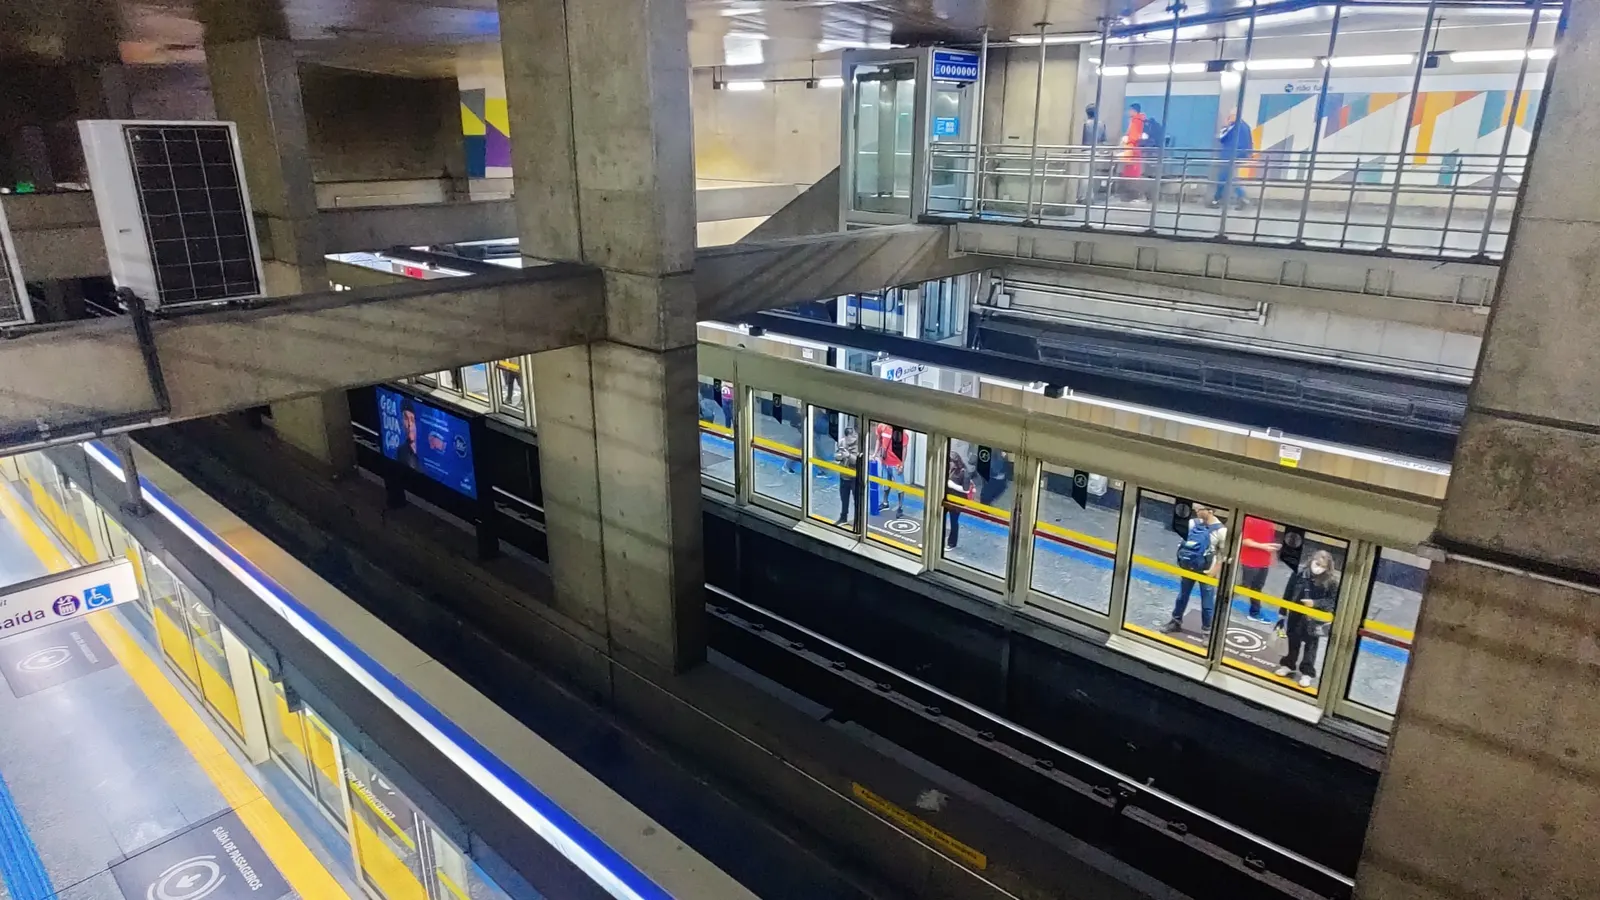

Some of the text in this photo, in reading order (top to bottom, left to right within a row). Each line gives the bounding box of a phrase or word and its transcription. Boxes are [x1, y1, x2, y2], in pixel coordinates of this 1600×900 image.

[0, 610, 46, 630] aída
[212, 826, 231, 846] SAÍDA
[223, 841, 237, 853] DE
